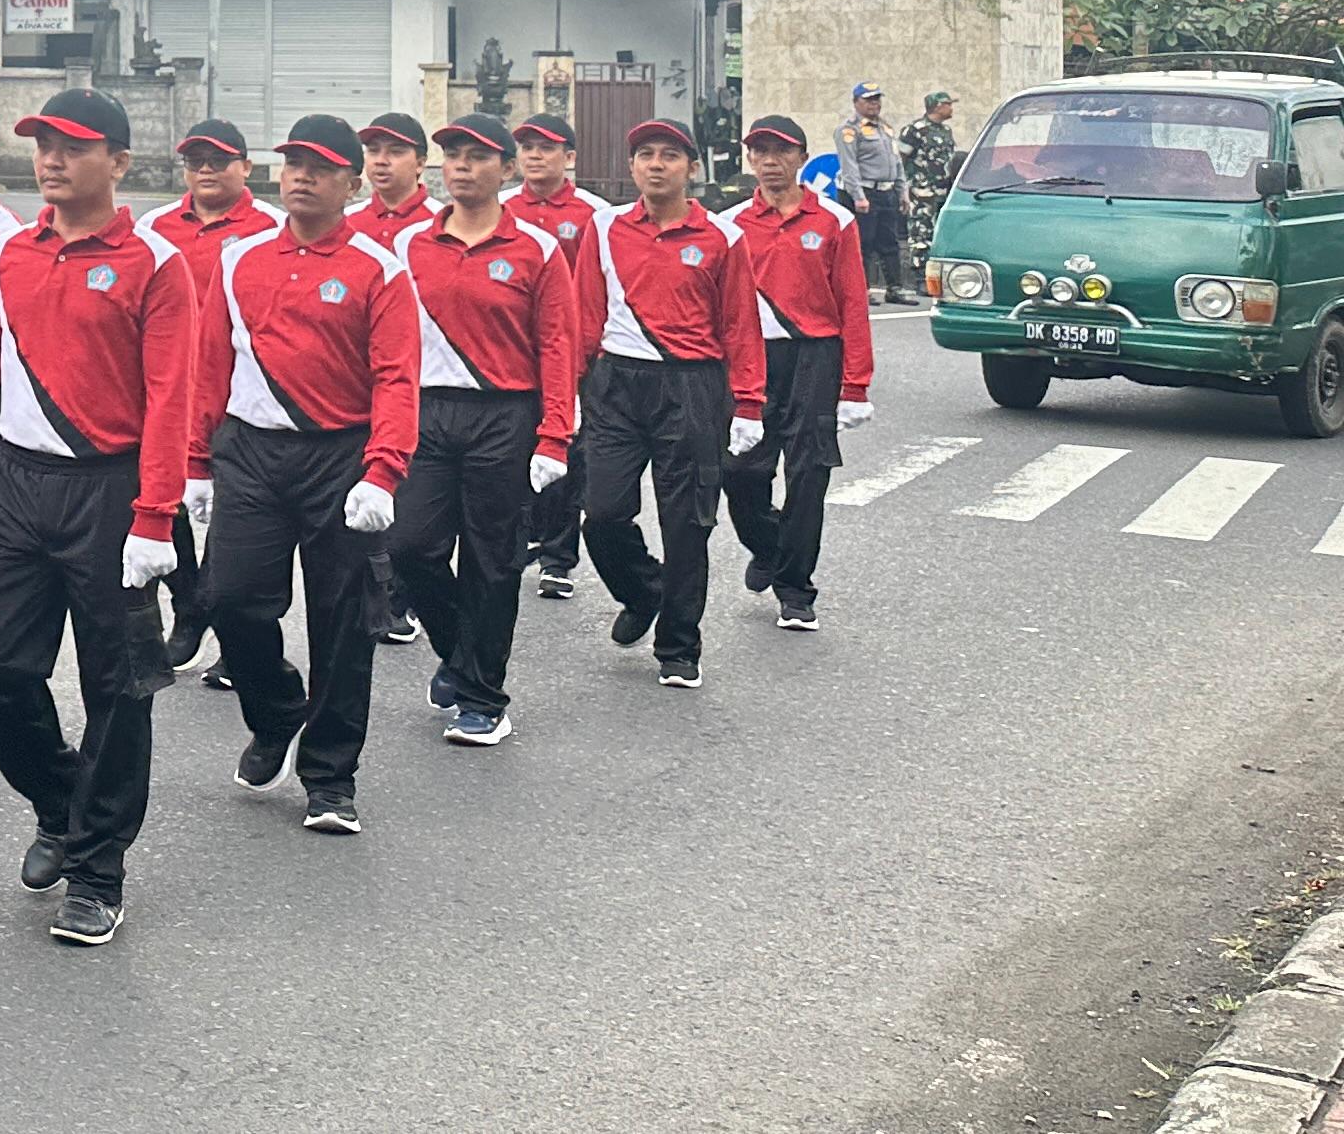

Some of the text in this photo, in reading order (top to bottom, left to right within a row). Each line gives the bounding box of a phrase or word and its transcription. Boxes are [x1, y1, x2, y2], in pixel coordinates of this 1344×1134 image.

[1026, 323, 1116, 345] DK 8358 MD
